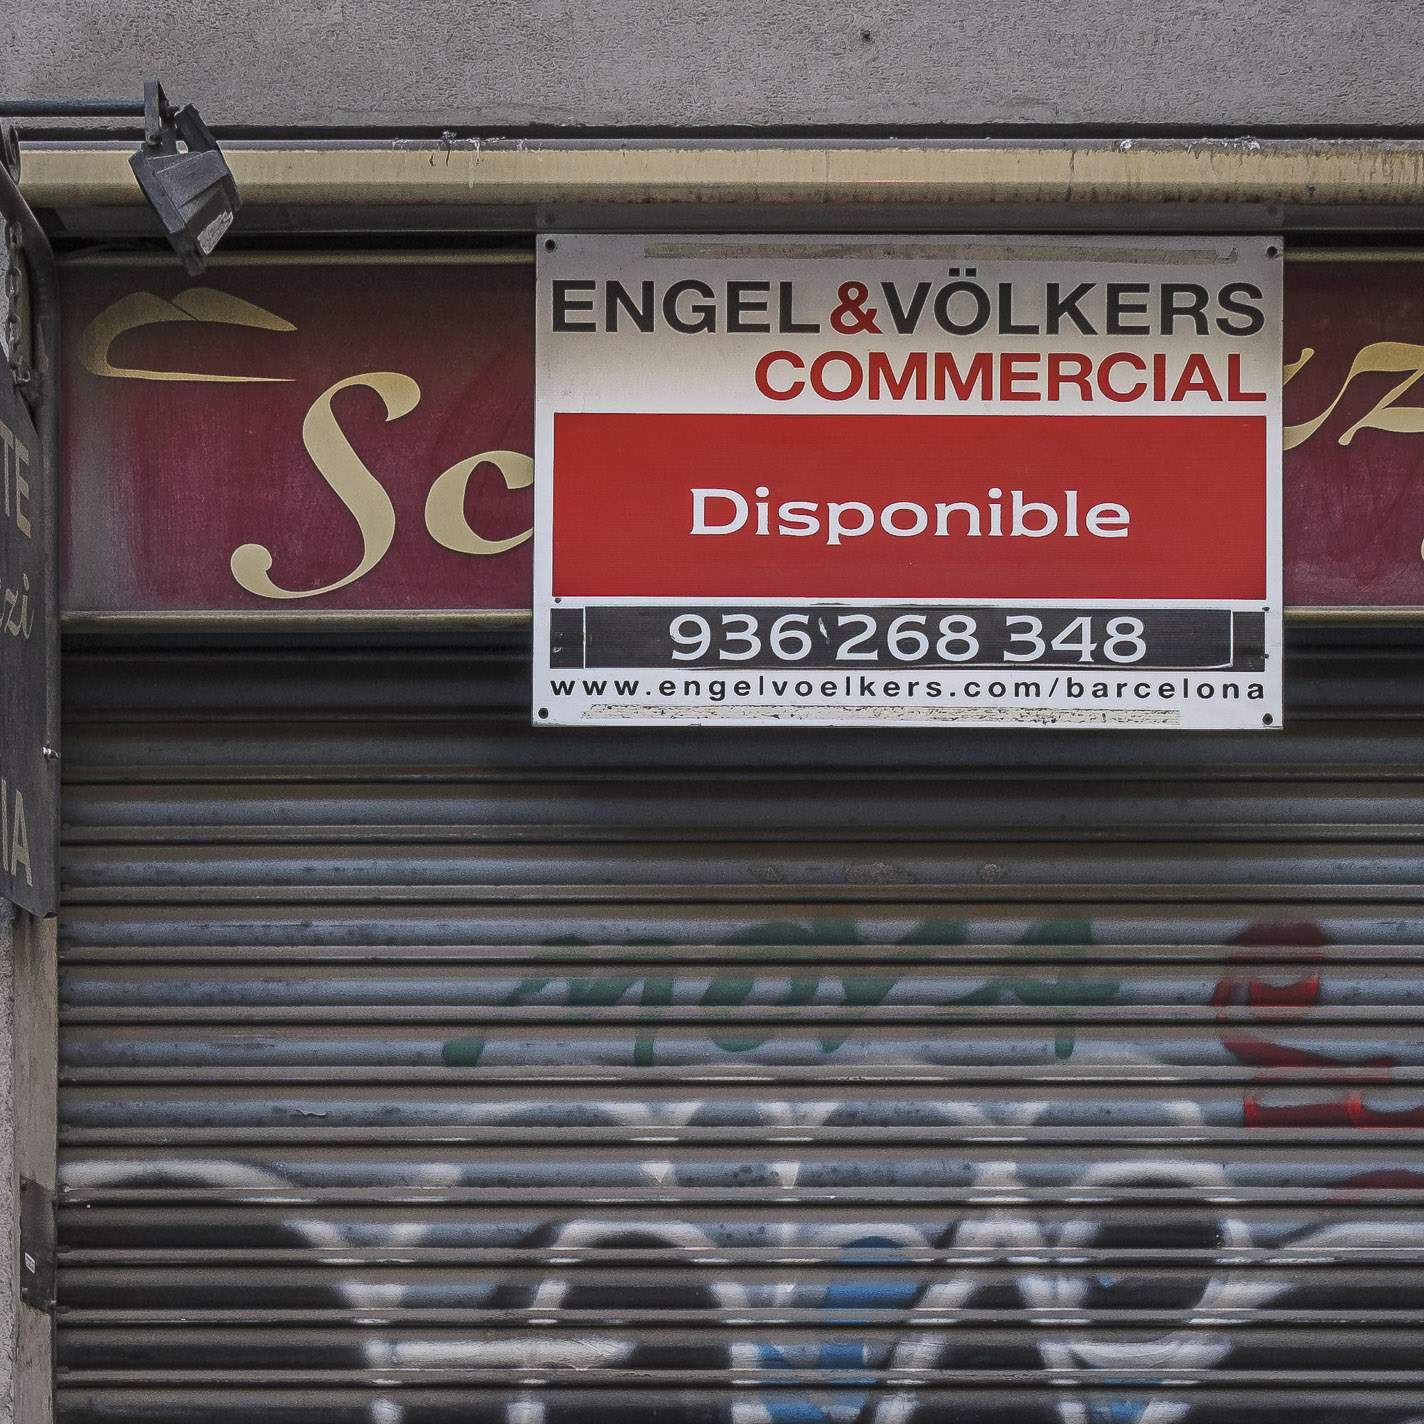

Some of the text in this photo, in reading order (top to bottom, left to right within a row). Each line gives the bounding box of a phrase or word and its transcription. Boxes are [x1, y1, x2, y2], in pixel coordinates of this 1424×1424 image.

[551, 268, 1266, 336] ENGEL&VÖLKERS
[754, 350, 1267, 403] COMMERCIAL
[688, 486, 1132, 546] Disponible
[668, 612, 1148, 665] 936 268 348
[550, 675, 1266, 703] www.engelvoelkers.com/barcelona
